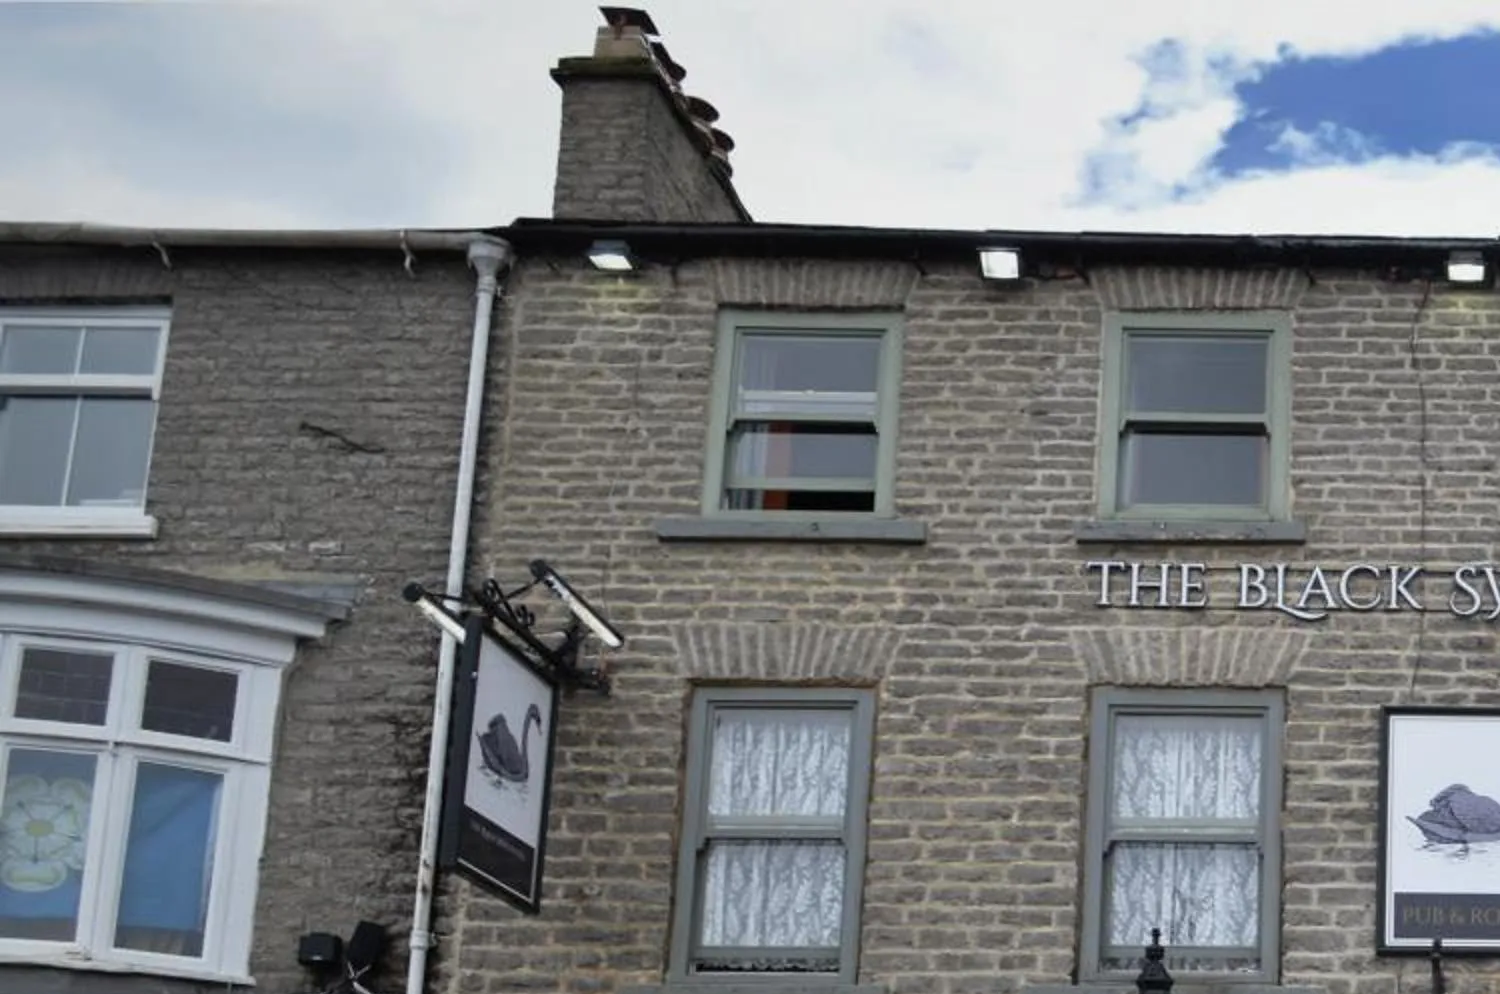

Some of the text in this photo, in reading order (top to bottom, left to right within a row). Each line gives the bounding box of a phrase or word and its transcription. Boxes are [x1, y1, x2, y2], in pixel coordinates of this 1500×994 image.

[1086, 560, 1207, 607] THE
[1236, 562, 1424, 621] BLACK
[1403, 906, 1444, 924] PUB
